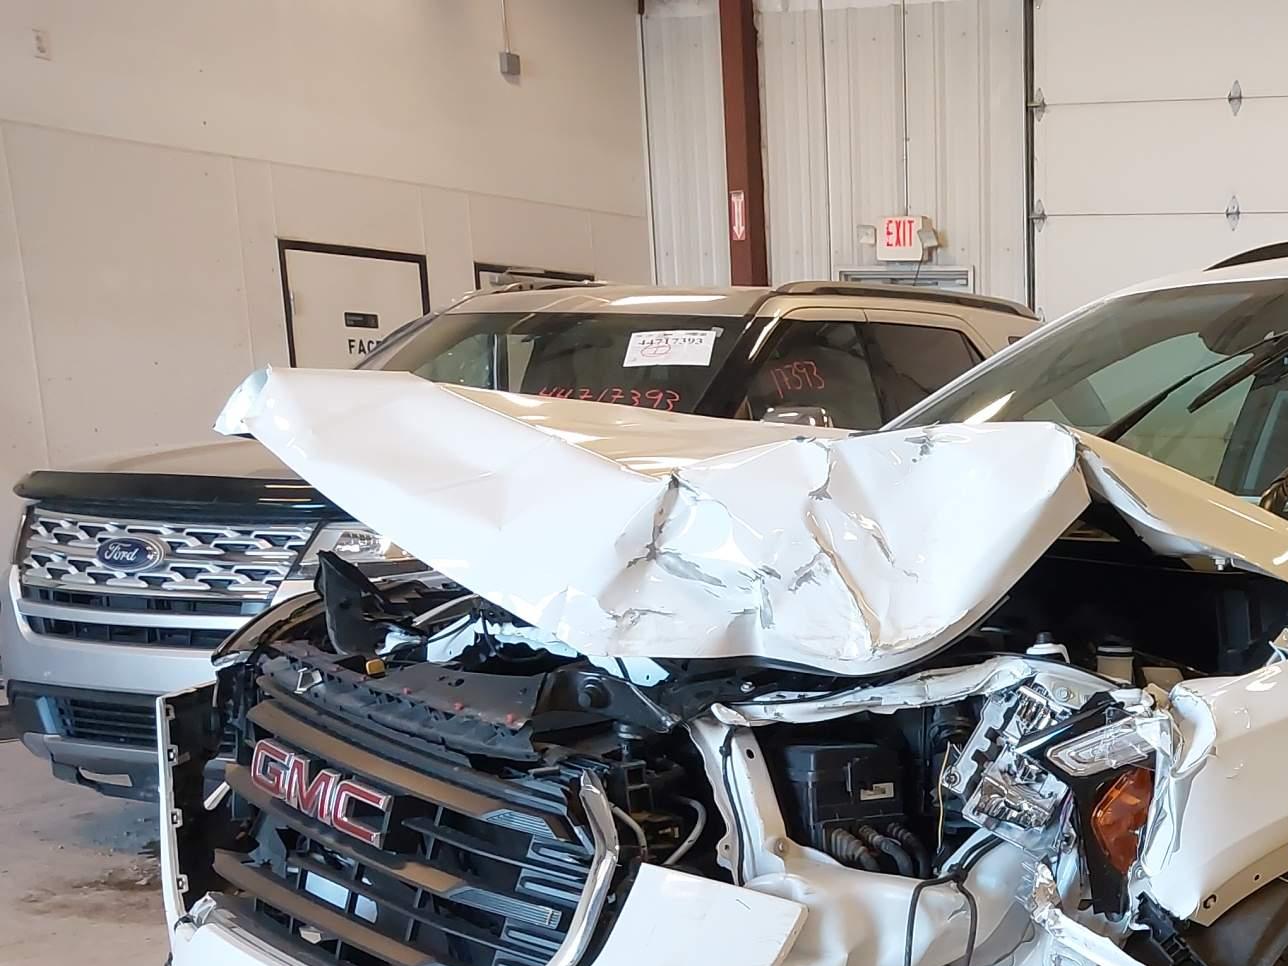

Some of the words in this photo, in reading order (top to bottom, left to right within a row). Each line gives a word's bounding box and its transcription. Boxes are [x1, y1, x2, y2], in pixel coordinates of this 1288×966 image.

[886, 219, 915, 247] EXIT
[638, 337, 704, 346] 44717393
[104, 541, 140, 561] Ford
[252, 739, 392, 849] GMC
